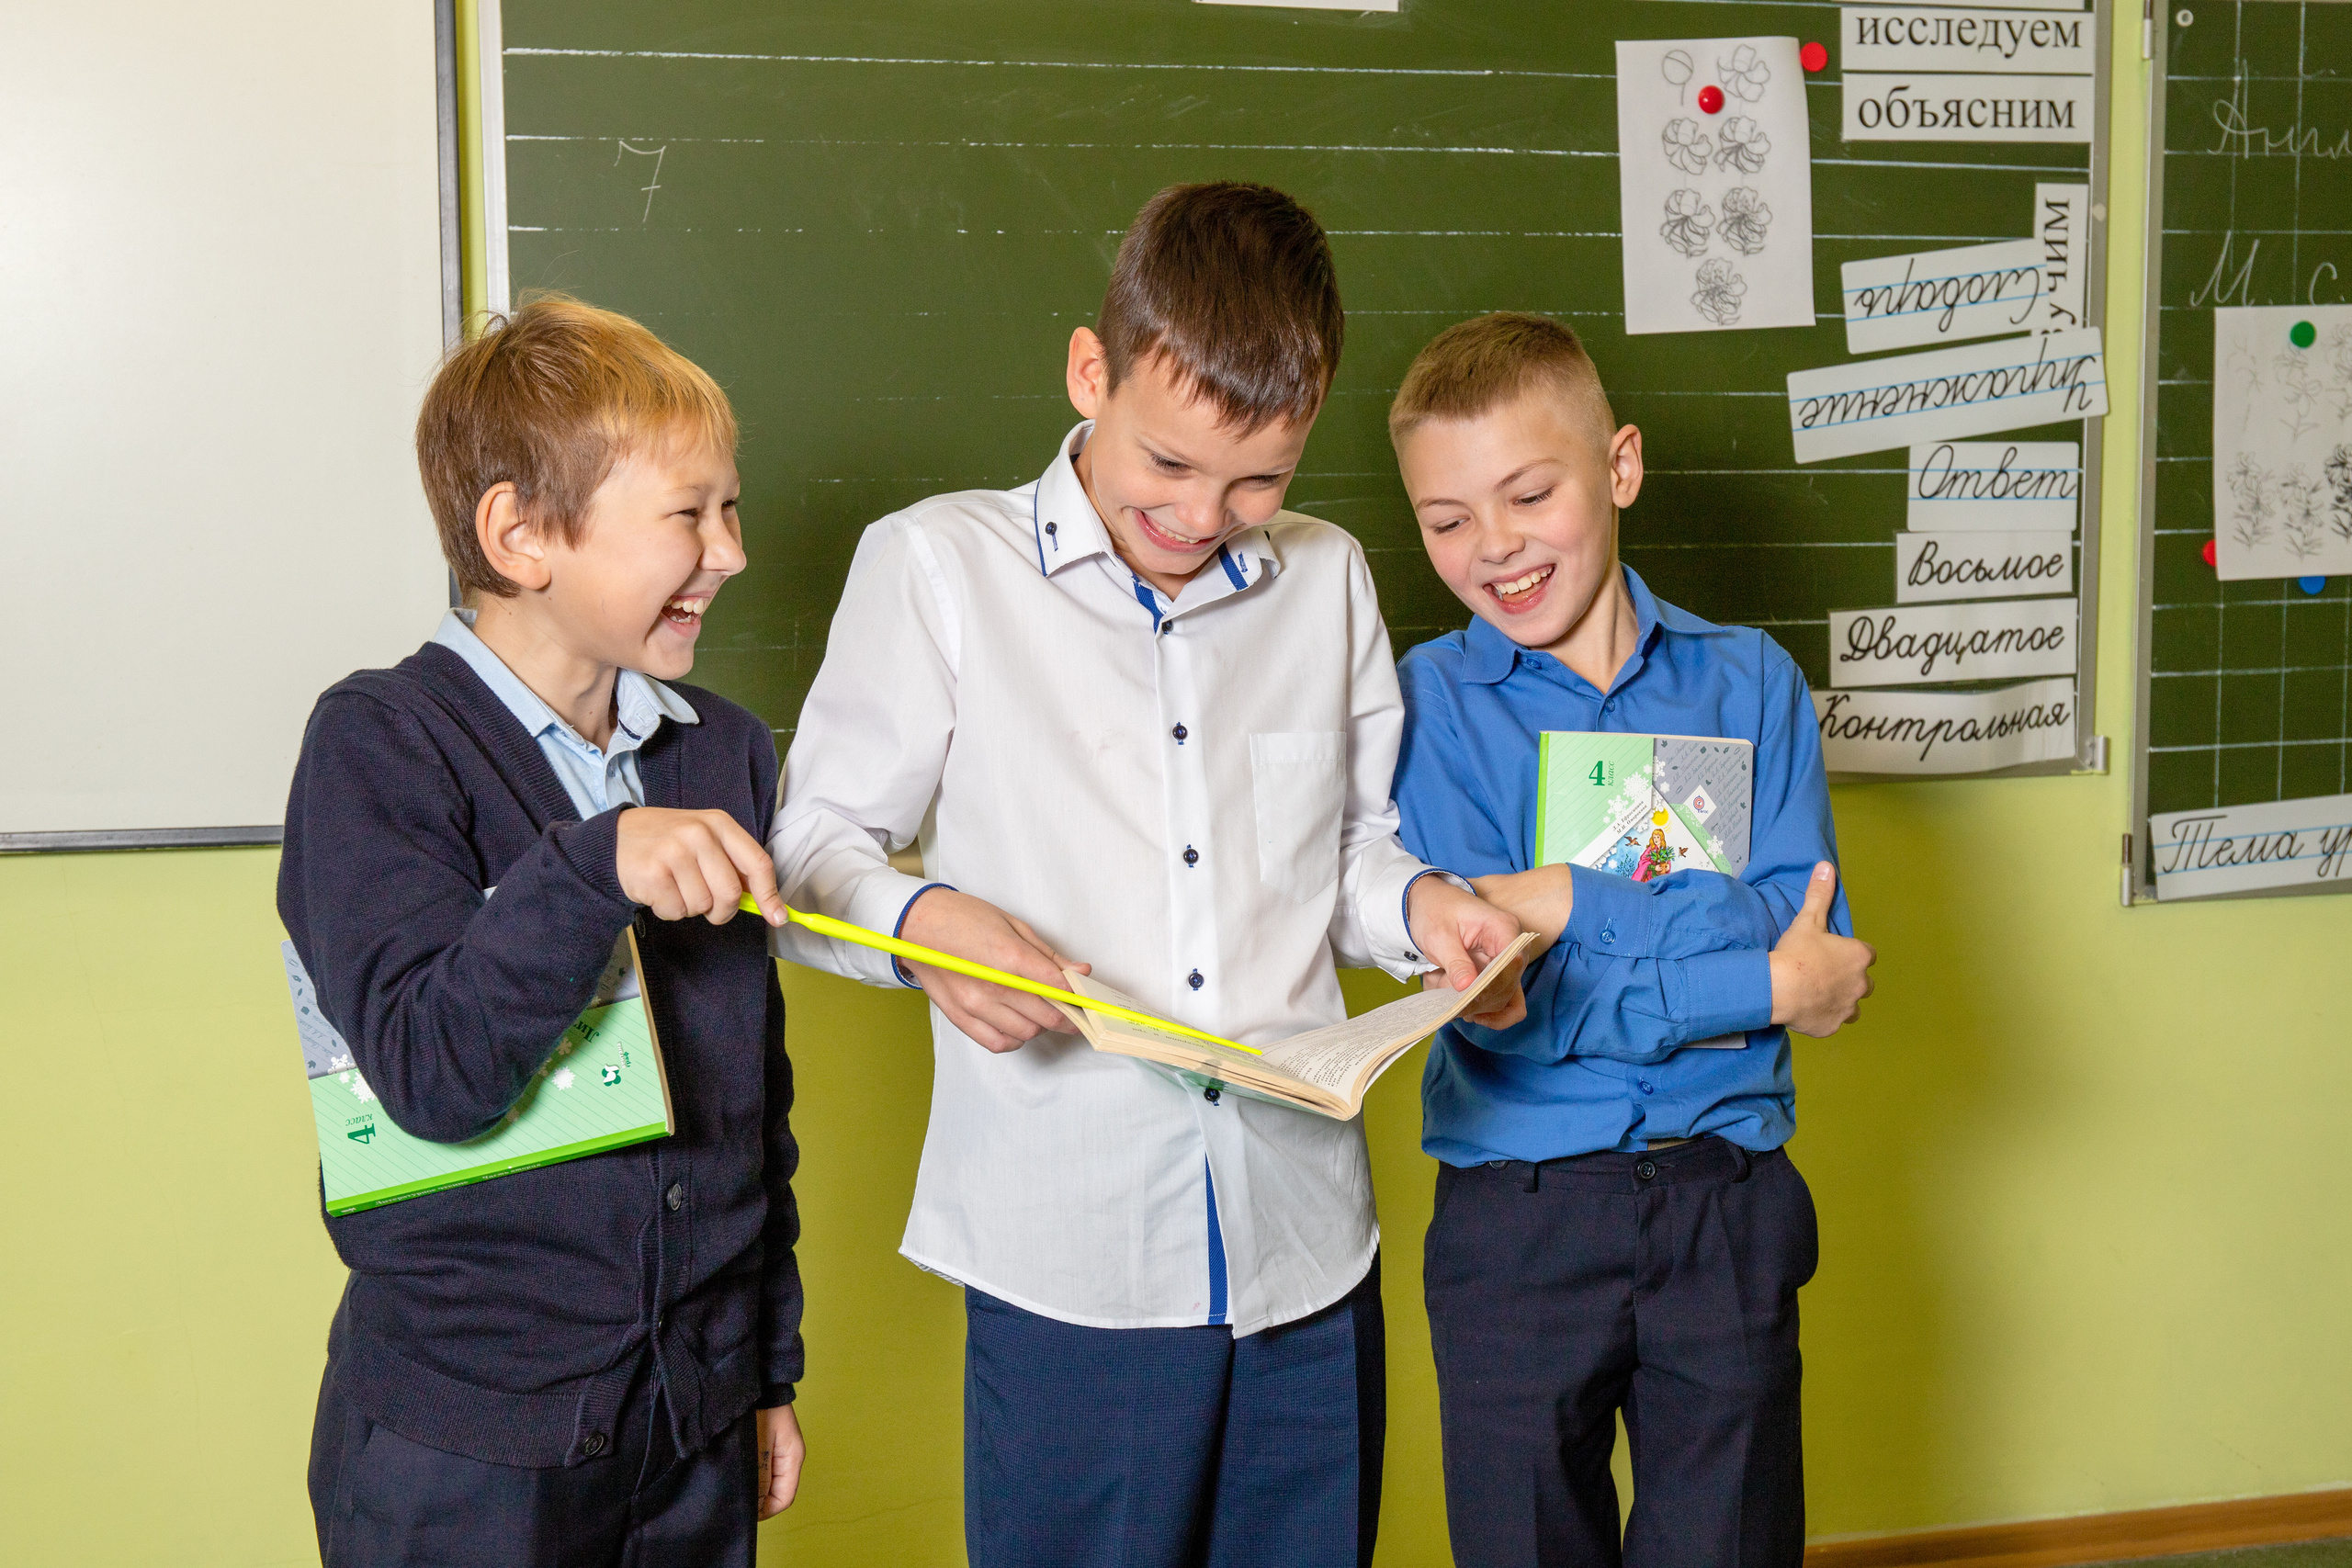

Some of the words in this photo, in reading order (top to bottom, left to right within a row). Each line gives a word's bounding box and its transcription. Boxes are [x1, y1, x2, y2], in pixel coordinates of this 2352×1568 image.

[1856, 16, 2083, 60] исследуем
[1858, 85, 2075, 130] объясним
[2041, 197, 2077, 335] учим
[1854, 257, 2041, 333] Словарь
[1798, 337, 2096, 428] Упражнение
[1917, 444, 2076, 500] Ответ
[1907, 540, 2064, 586] Восьмое
[1839, 615, 2064, 676] Двадцатое
[1819, 694, 2070, 761] Контрольная
[1588, 760, 1606, 786] 4
[1607, 760, 1615, 787] класс
[2163, 814, 2304, 874] Тема
[345, 1112, 373, 1127] класс
[346, 1122, 377, 1145] 4
